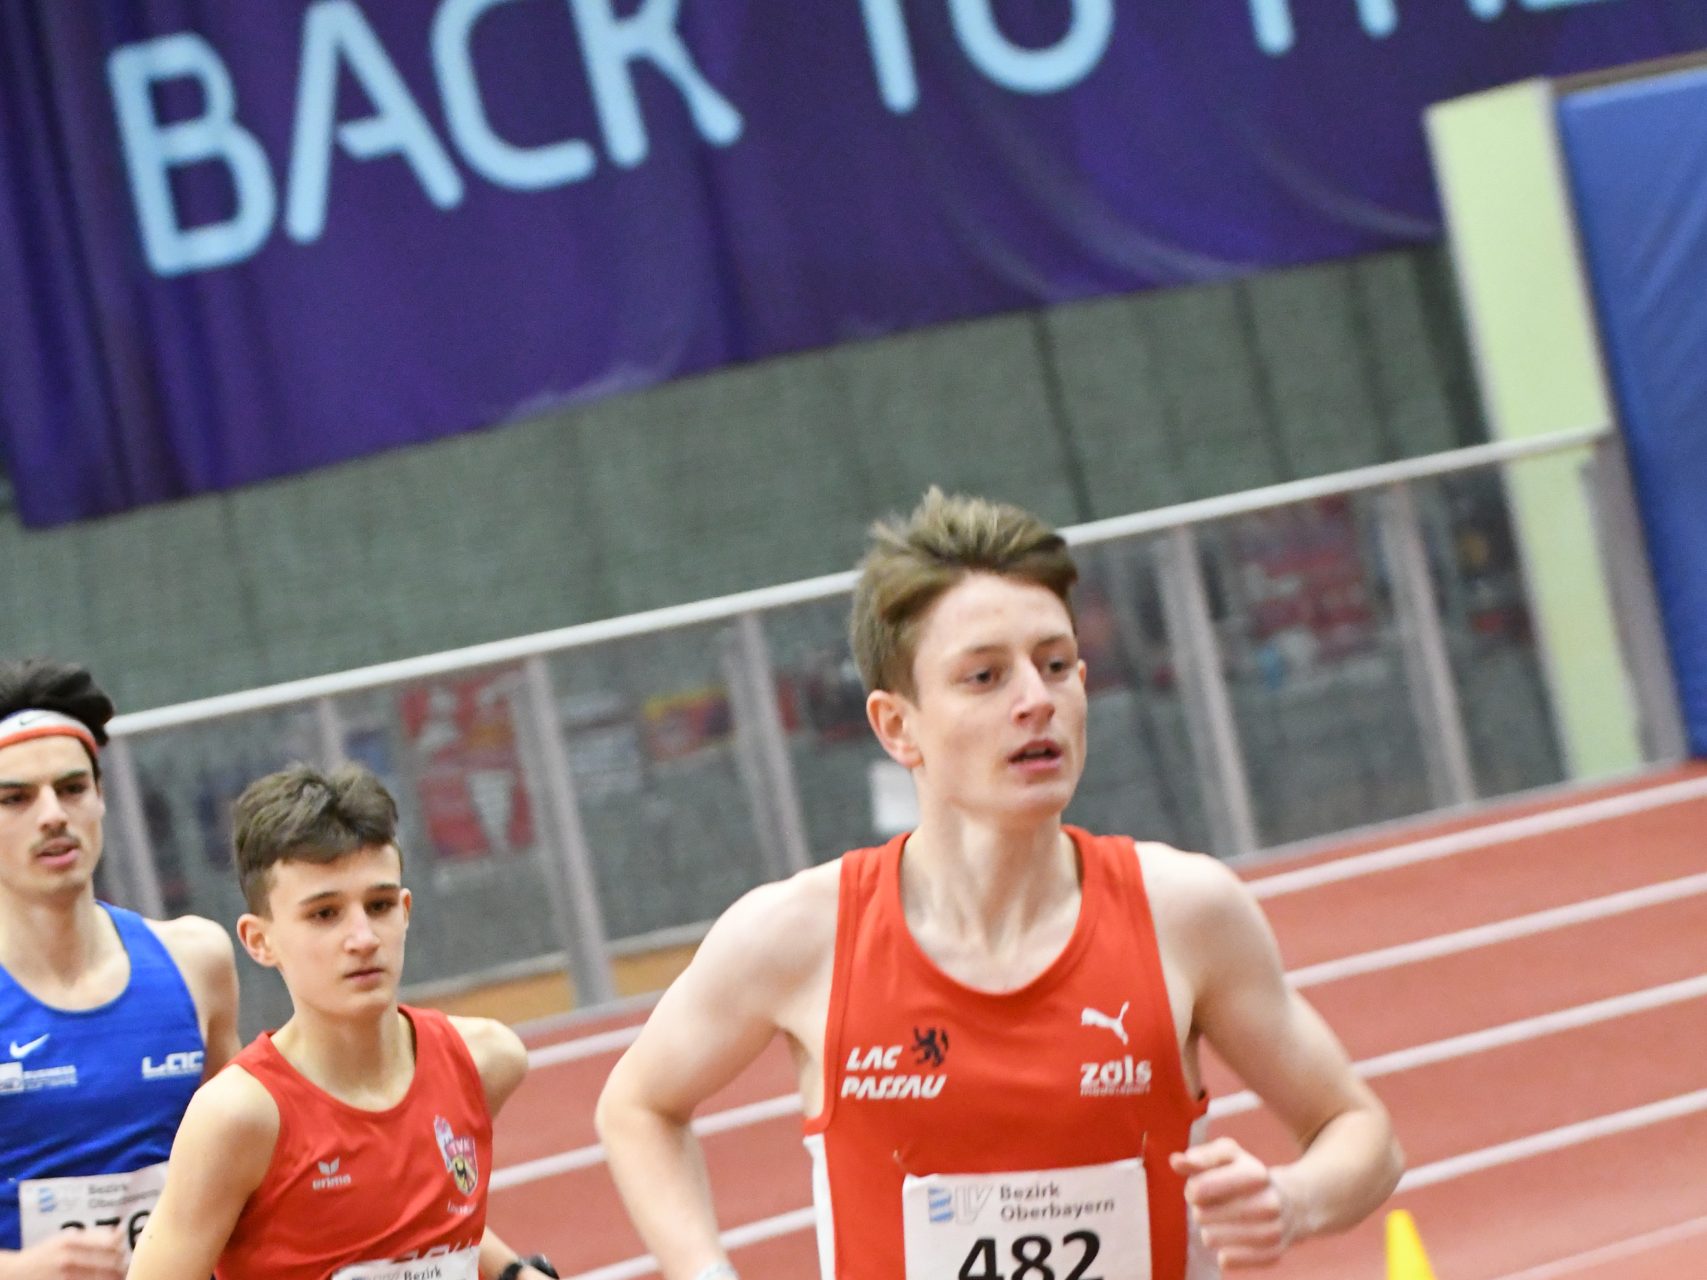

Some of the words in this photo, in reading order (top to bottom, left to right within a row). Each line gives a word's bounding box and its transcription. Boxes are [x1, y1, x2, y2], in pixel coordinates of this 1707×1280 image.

[108, 0, 742, 277] BACK
[845, 1045, 903, 1071] LAC
[841, 1073, 947, 1100] PASSAU
[1000, 1181, 1060, 1201] Bezirk
[1000, 1199, 1115, 1222] Oberbayern
